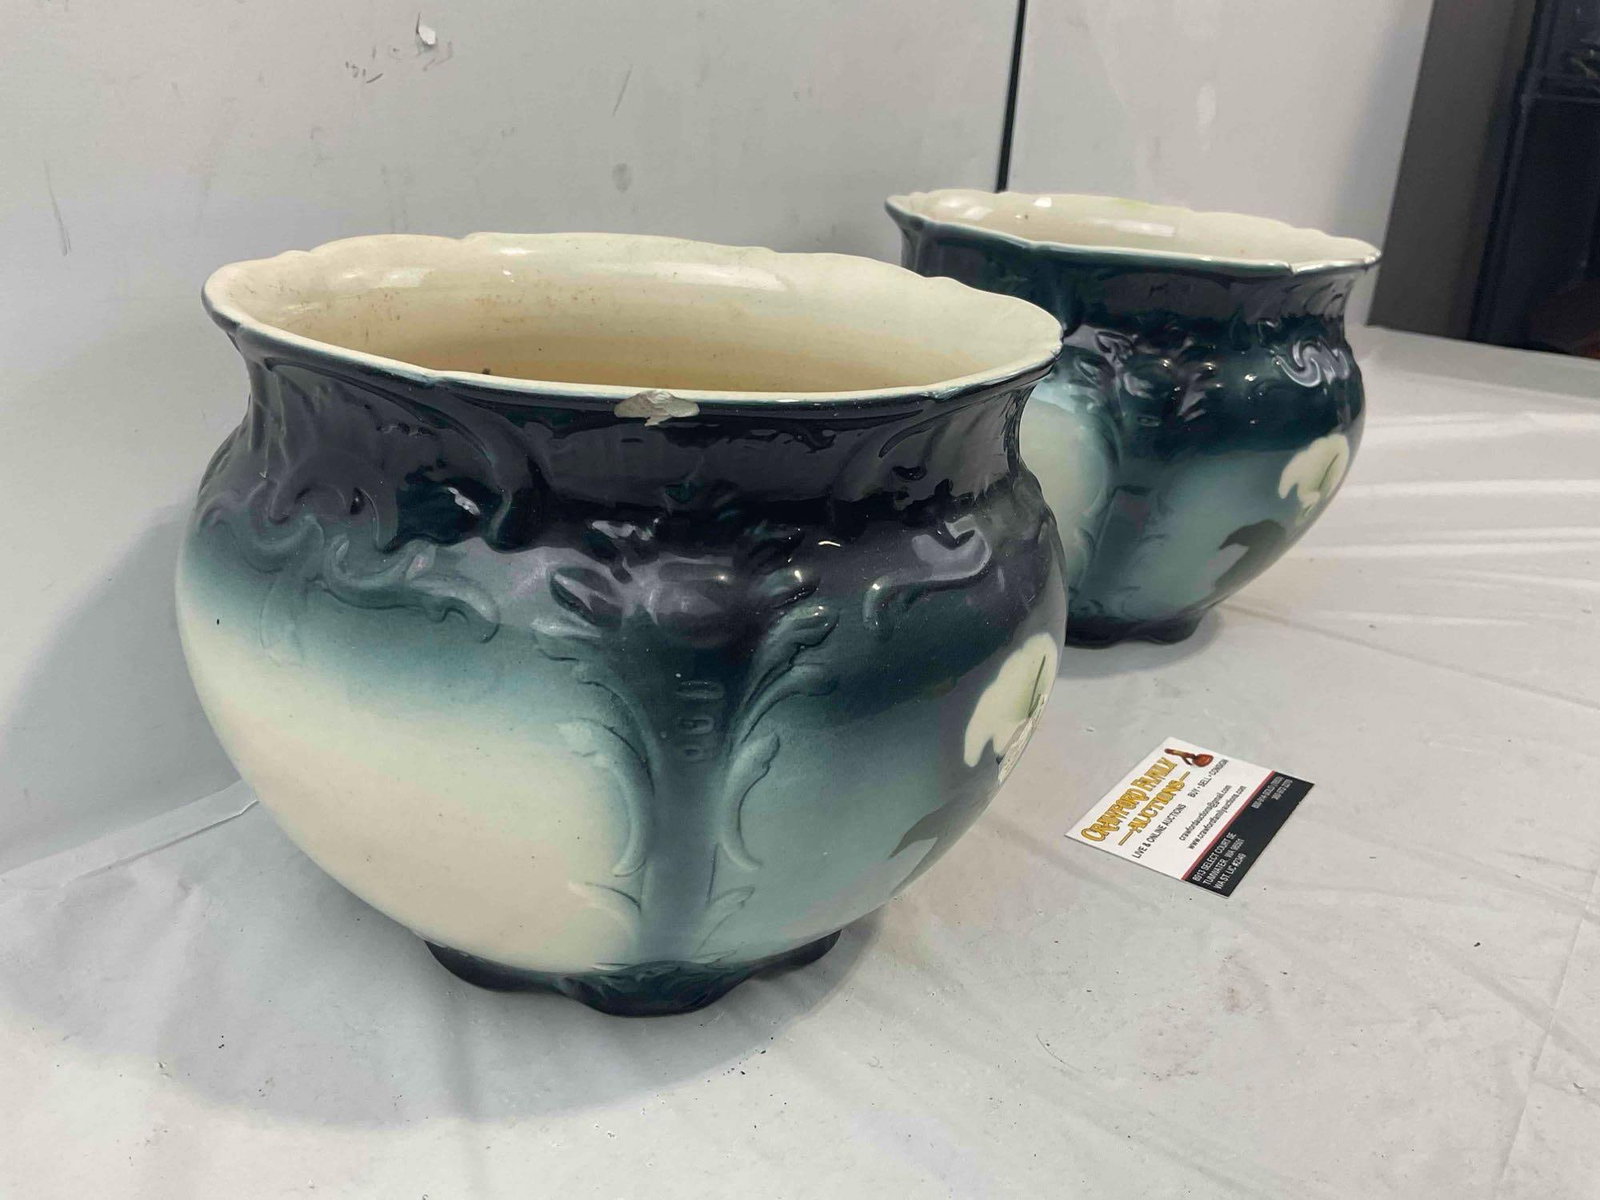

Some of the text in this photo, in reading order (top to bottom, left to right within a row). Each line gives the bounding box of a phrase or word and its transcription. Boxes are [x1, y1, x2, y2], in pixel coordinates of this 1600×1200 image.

[1081, 757, 1176, 840] CRAWFORD FAMILY
[1128, 779, 1184, 832] AUCTIONS
[1187, 788, 1199, 797] BUY
[1197, 778, 1211, 787] SELL
[1132, 846, 1147, 858] LIVE
[1146, 824, 1167, 842] ONLINE
[1162, 804, 1186, 826] AUCTIONS
[1200, 852, 1219, 870] SELECT
[1214, 838, 1230, 853] COURT
